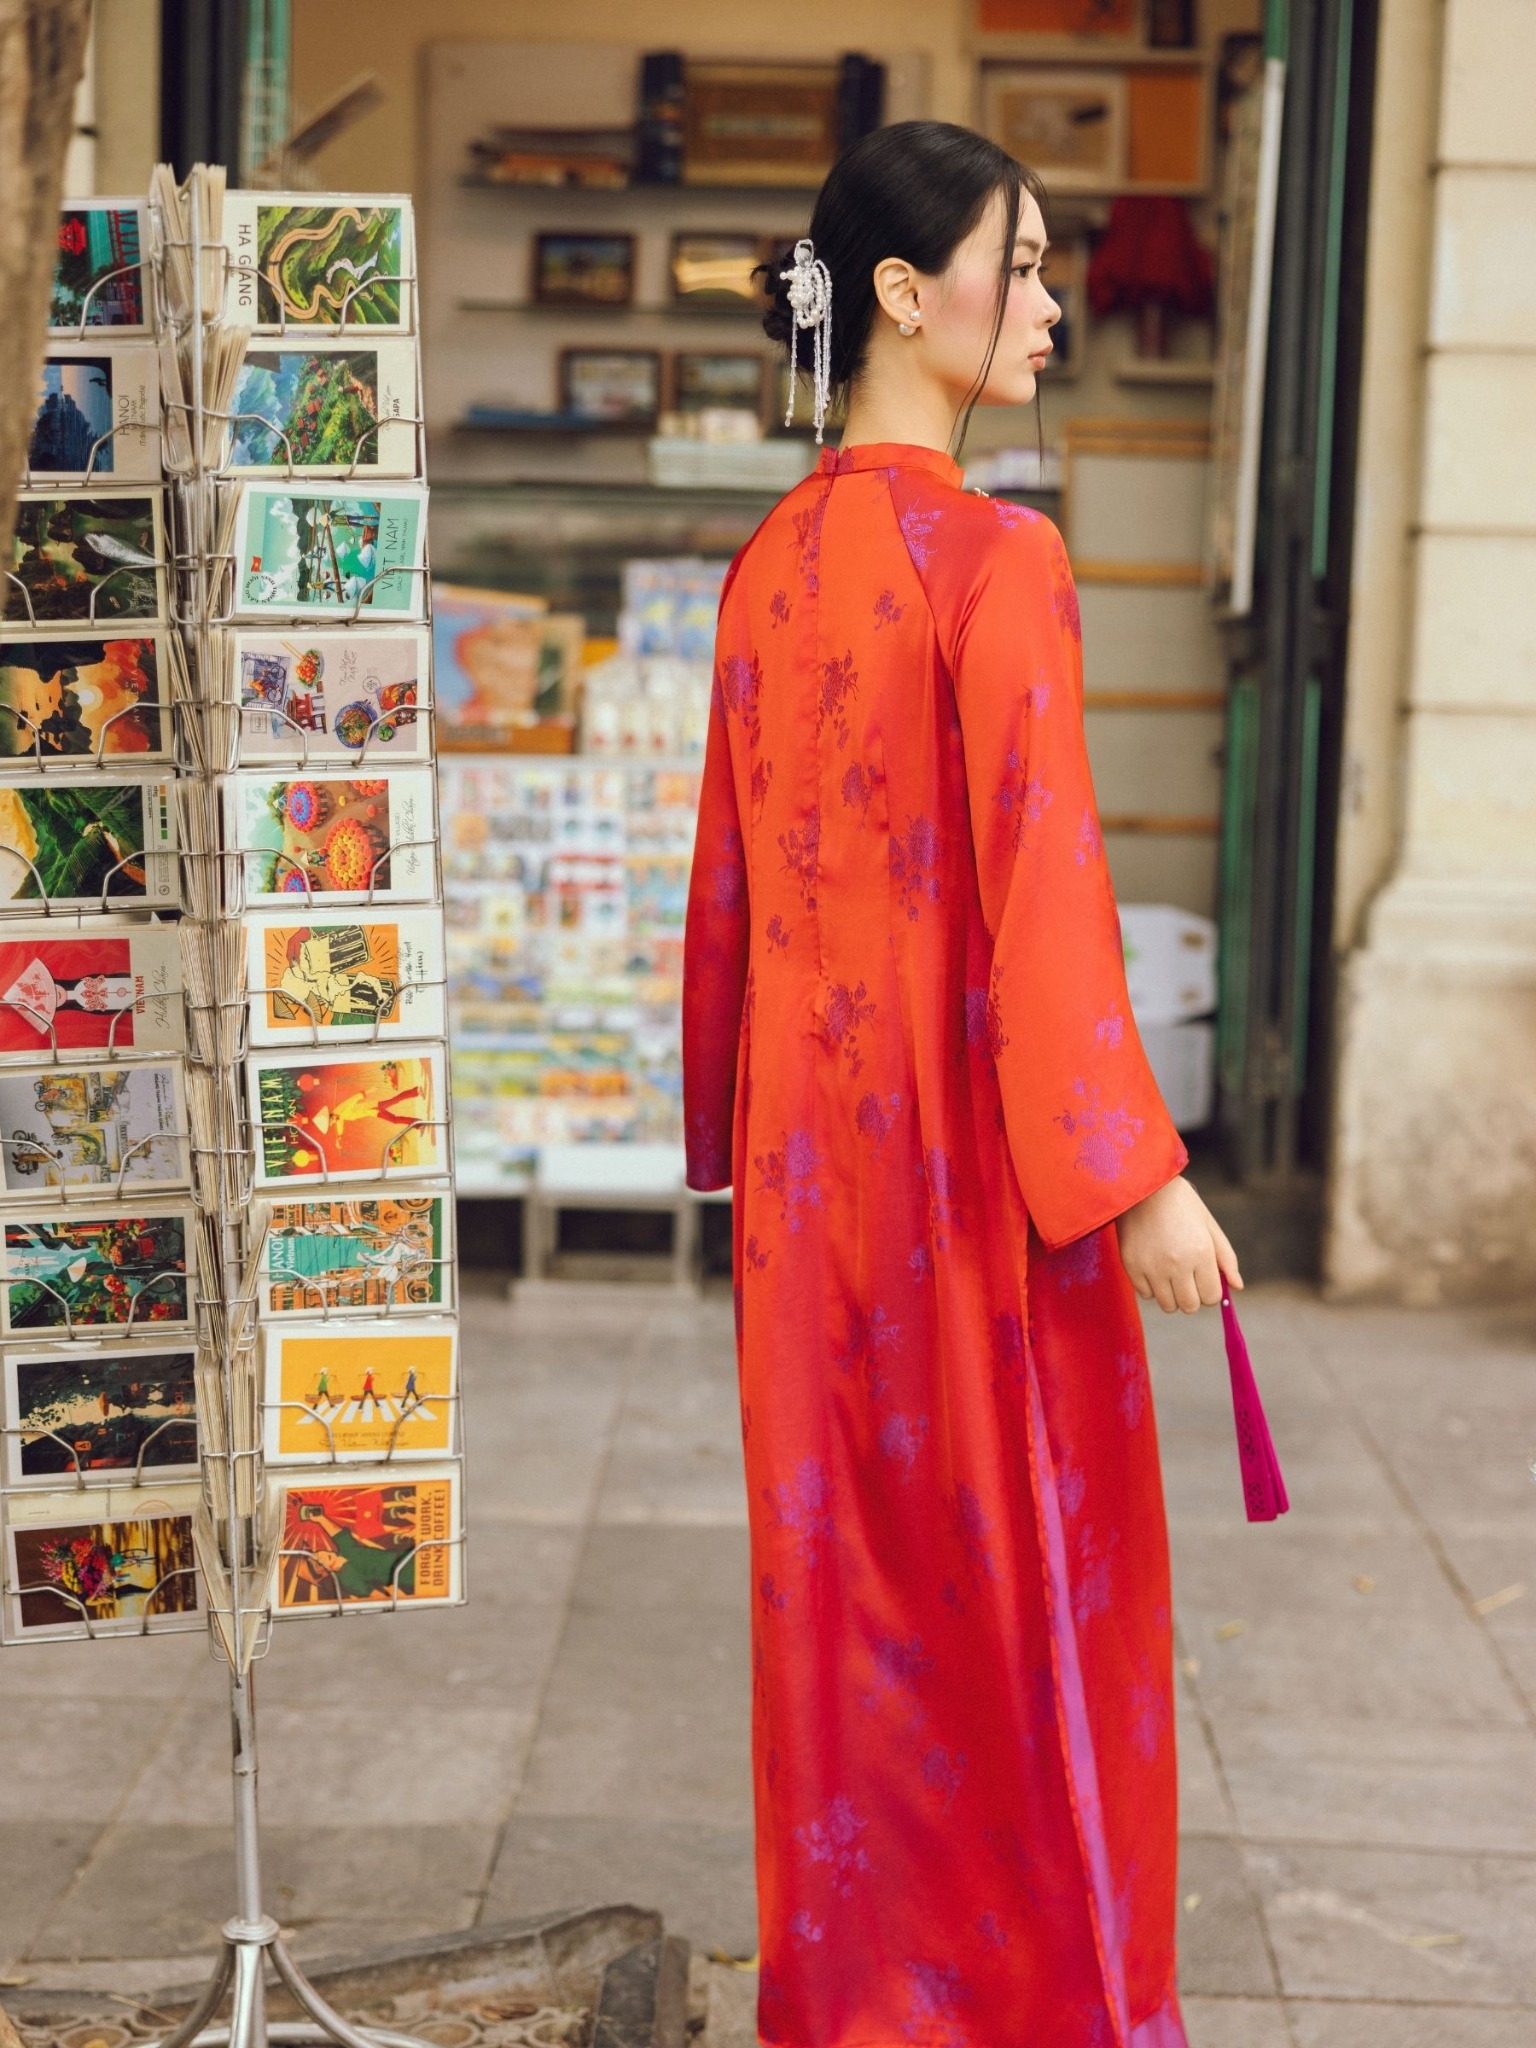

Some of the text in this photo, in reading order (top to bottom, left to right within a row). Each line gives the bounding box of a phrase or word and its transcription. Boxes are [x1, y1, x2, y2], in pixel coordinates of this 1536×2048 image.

[238, 224, 251, 246] HA
[118, 395, 130, 436] HANOI
[385, 518, 399, 550] NAM
[130, 670, 140, 723] VIETAM
[135, 976, 146, 1014] VIENAM
[260, 1078, 288, 1169] VIETNAM
[286, 1237, 295, 1269] Vietnam
[420, 1492, 432, 1585] FORGE WORK.
[433, 1545, 445, 1586] DRINK
